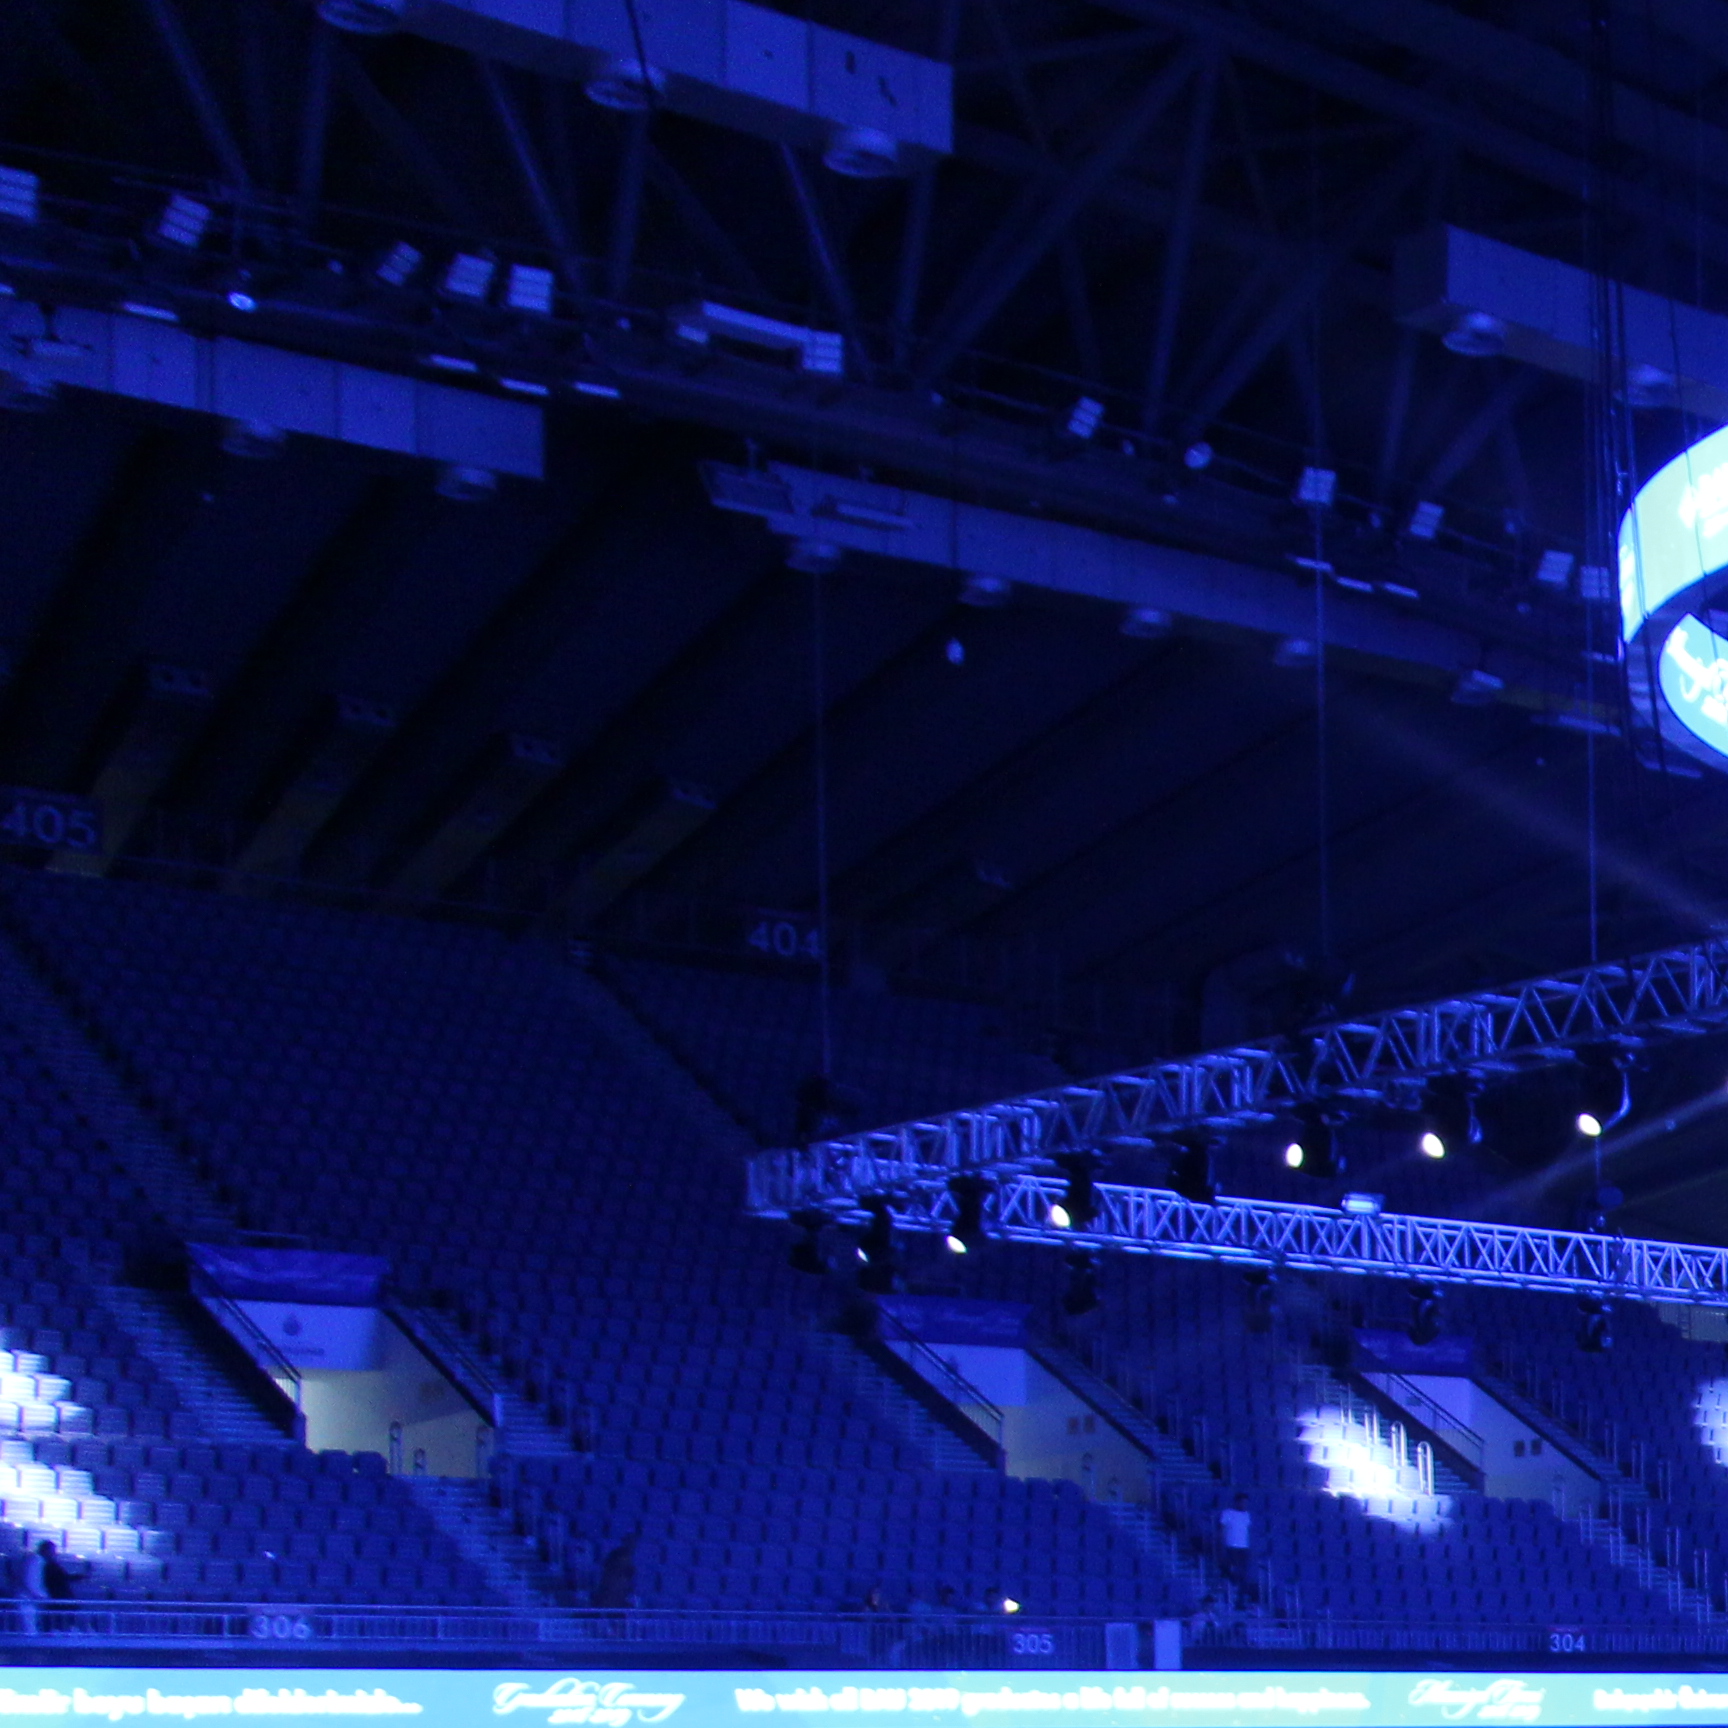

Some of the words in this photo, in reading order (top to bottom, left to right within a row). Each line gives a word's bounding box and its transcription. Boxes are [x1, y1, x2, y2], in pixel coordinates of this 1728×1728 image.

[248, 1615, 314, 1639] 306
[1013, 1633, 1056, 1654] 305
[1549, 1633, 1586, 1653] 304
